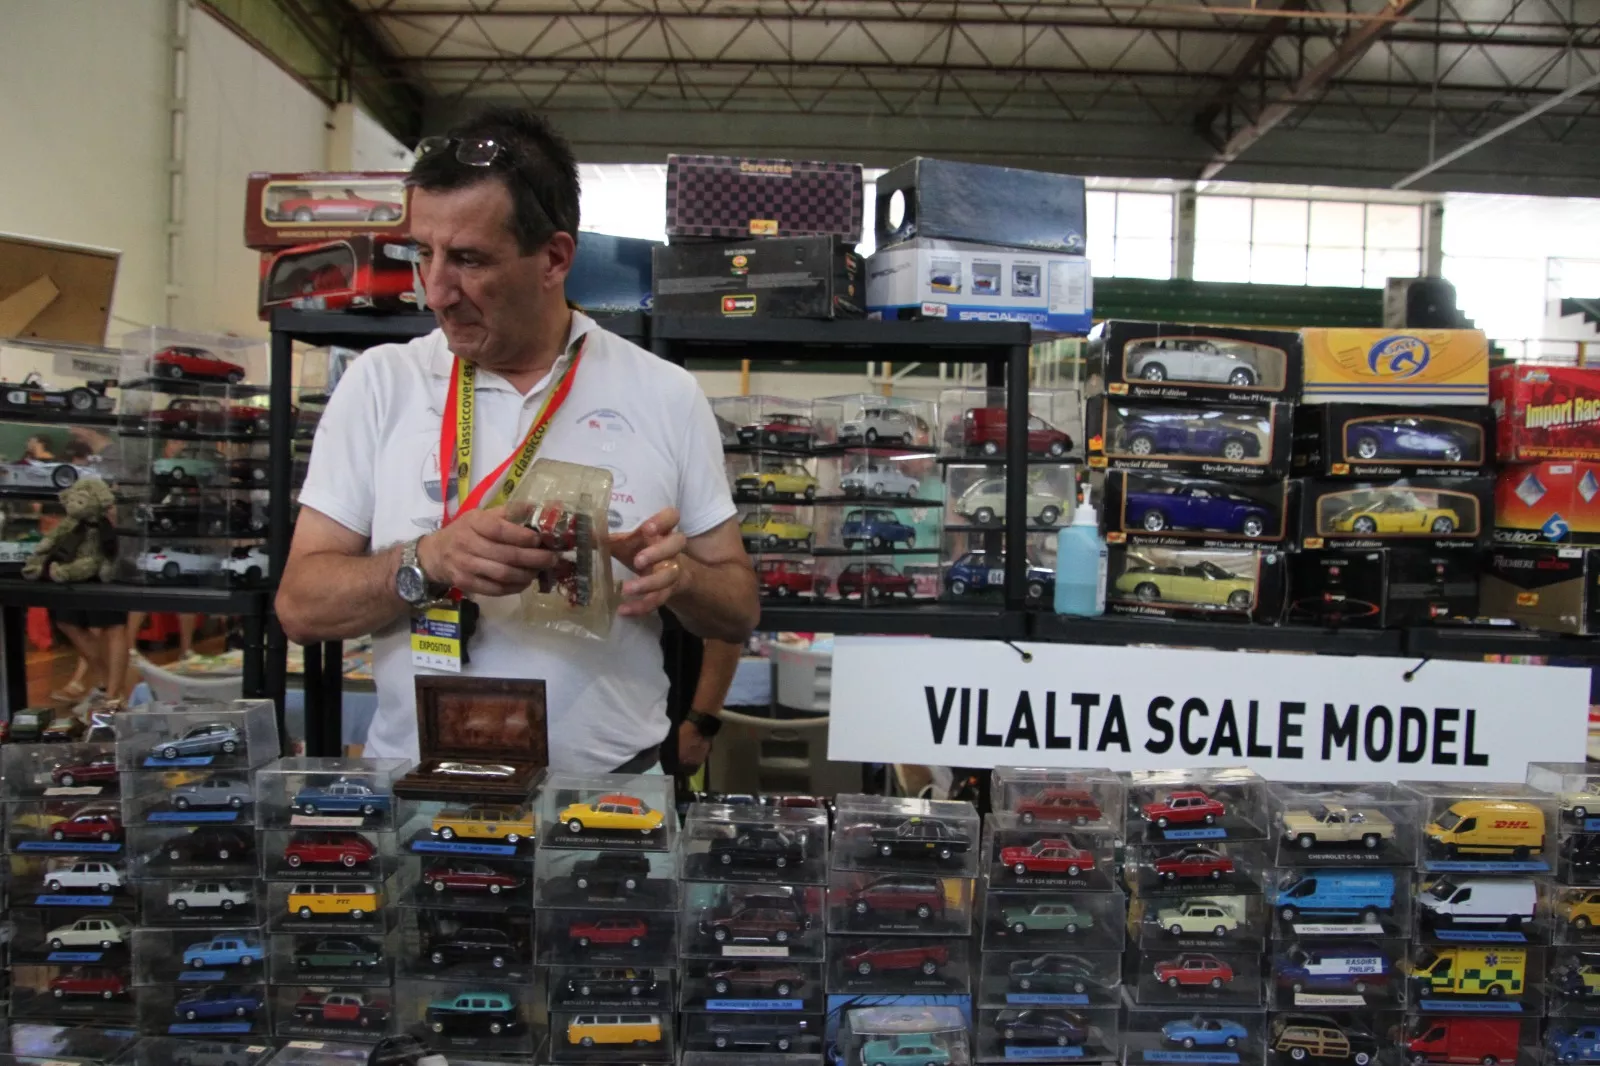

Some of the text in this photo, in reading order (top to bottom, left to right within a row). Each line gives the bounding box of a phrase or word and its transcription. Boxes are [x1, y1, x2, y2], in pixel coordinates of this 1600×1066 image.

[740, 162, 792, 173] Corvette
[959, 311, 1015, 322] SPECIAL
[459, 362, 473, 457] classiccover.es
[1526, 399, 1573, 429] Import
[419, 640, 453, 654] EXPOSITOR
[925, 687, 1488, 766] VILALTA SCALE MODEL
[1494, 819, 1529, 829] DHL
[1345, 958, 1377, 966] RASOIRS
